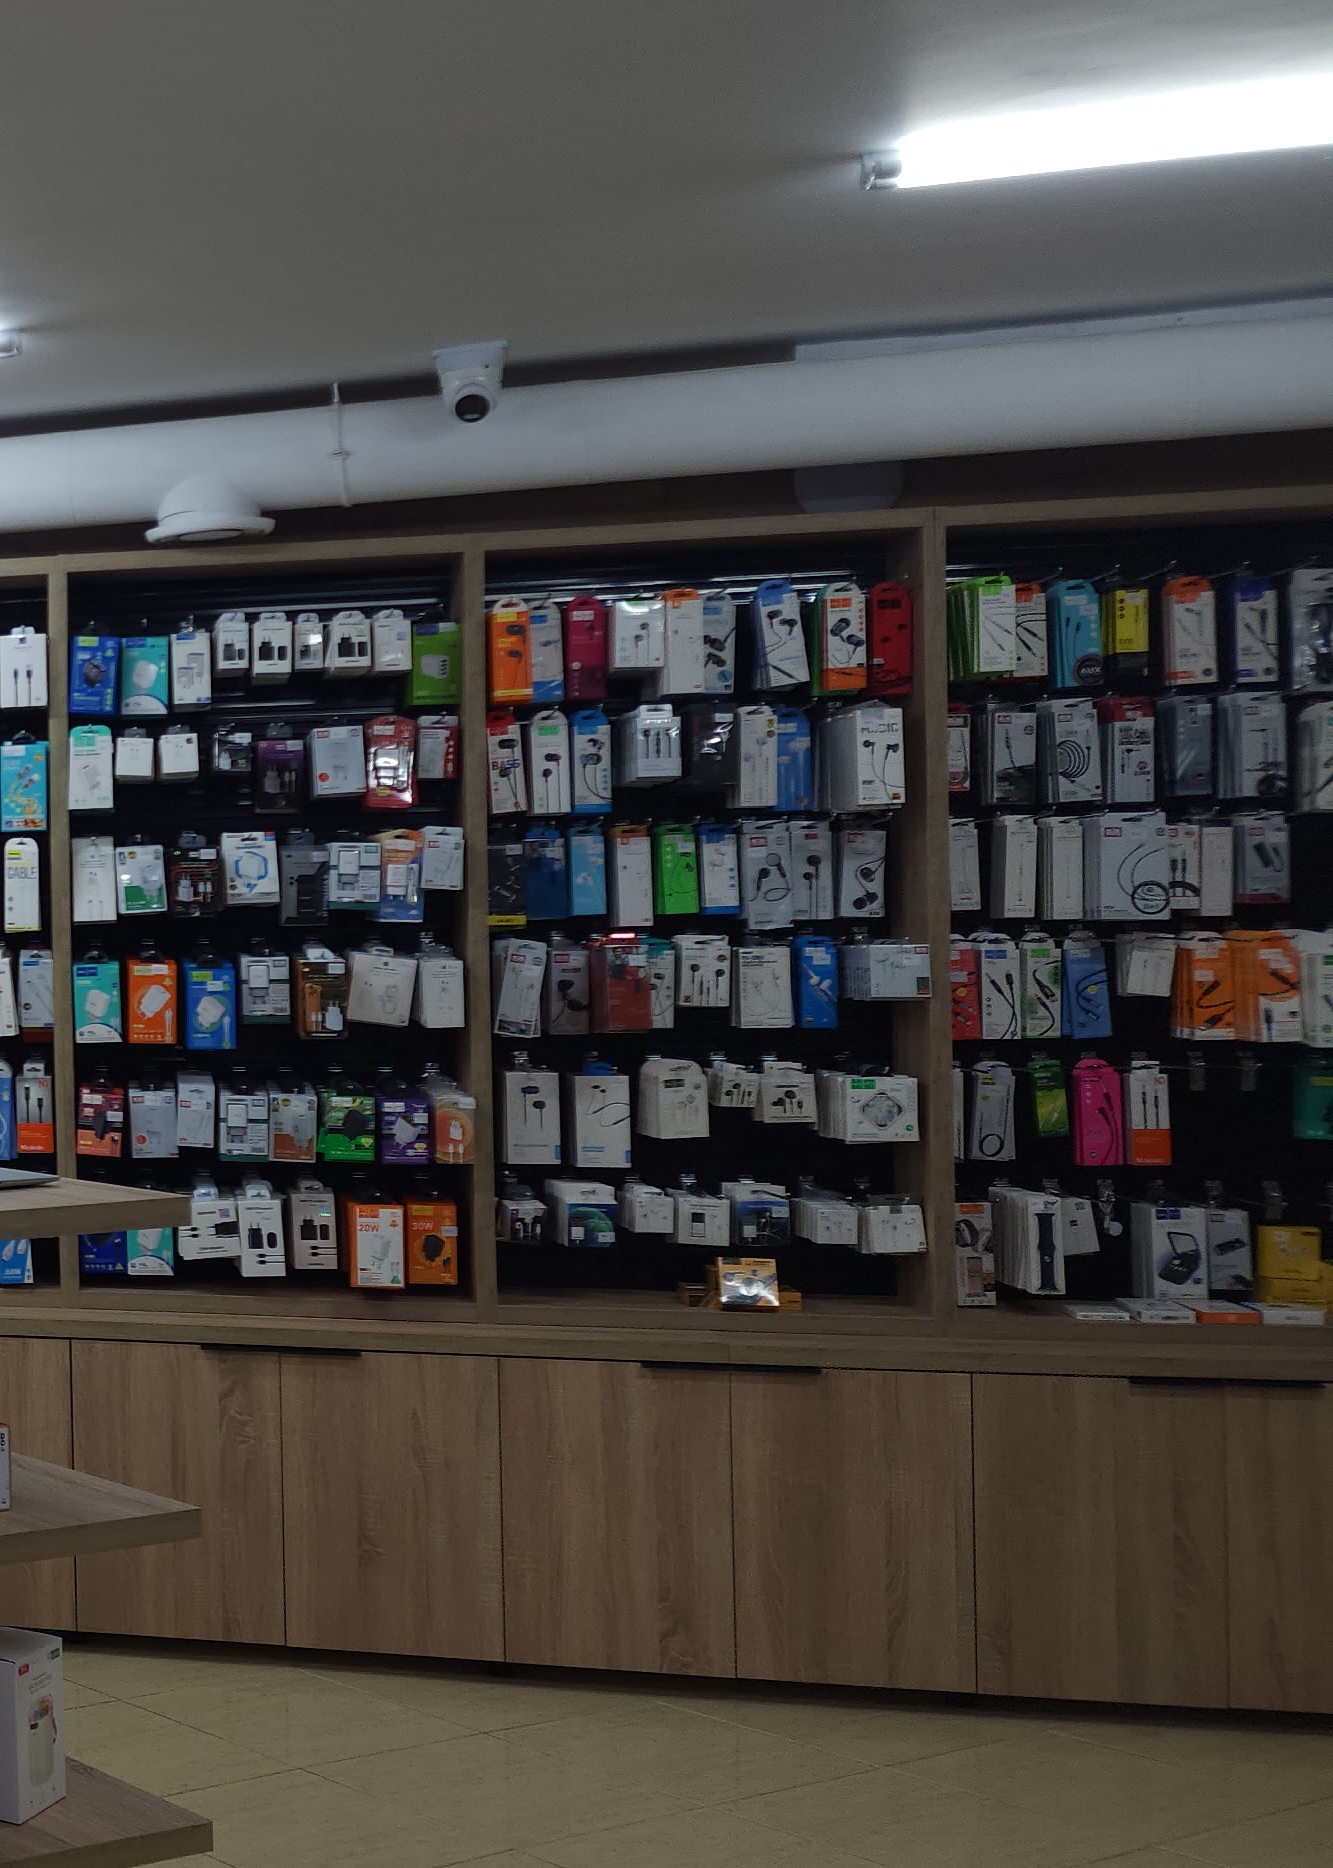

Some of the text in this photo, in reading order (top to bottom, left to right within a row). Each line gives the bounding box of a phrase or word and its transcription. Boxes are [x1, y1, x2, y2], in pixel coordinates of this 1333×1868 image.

[492, 759, 520, 771] BASS
[358, 1223, 380, 1232] 20W
[411, 1222, 434, 1231] 30W
